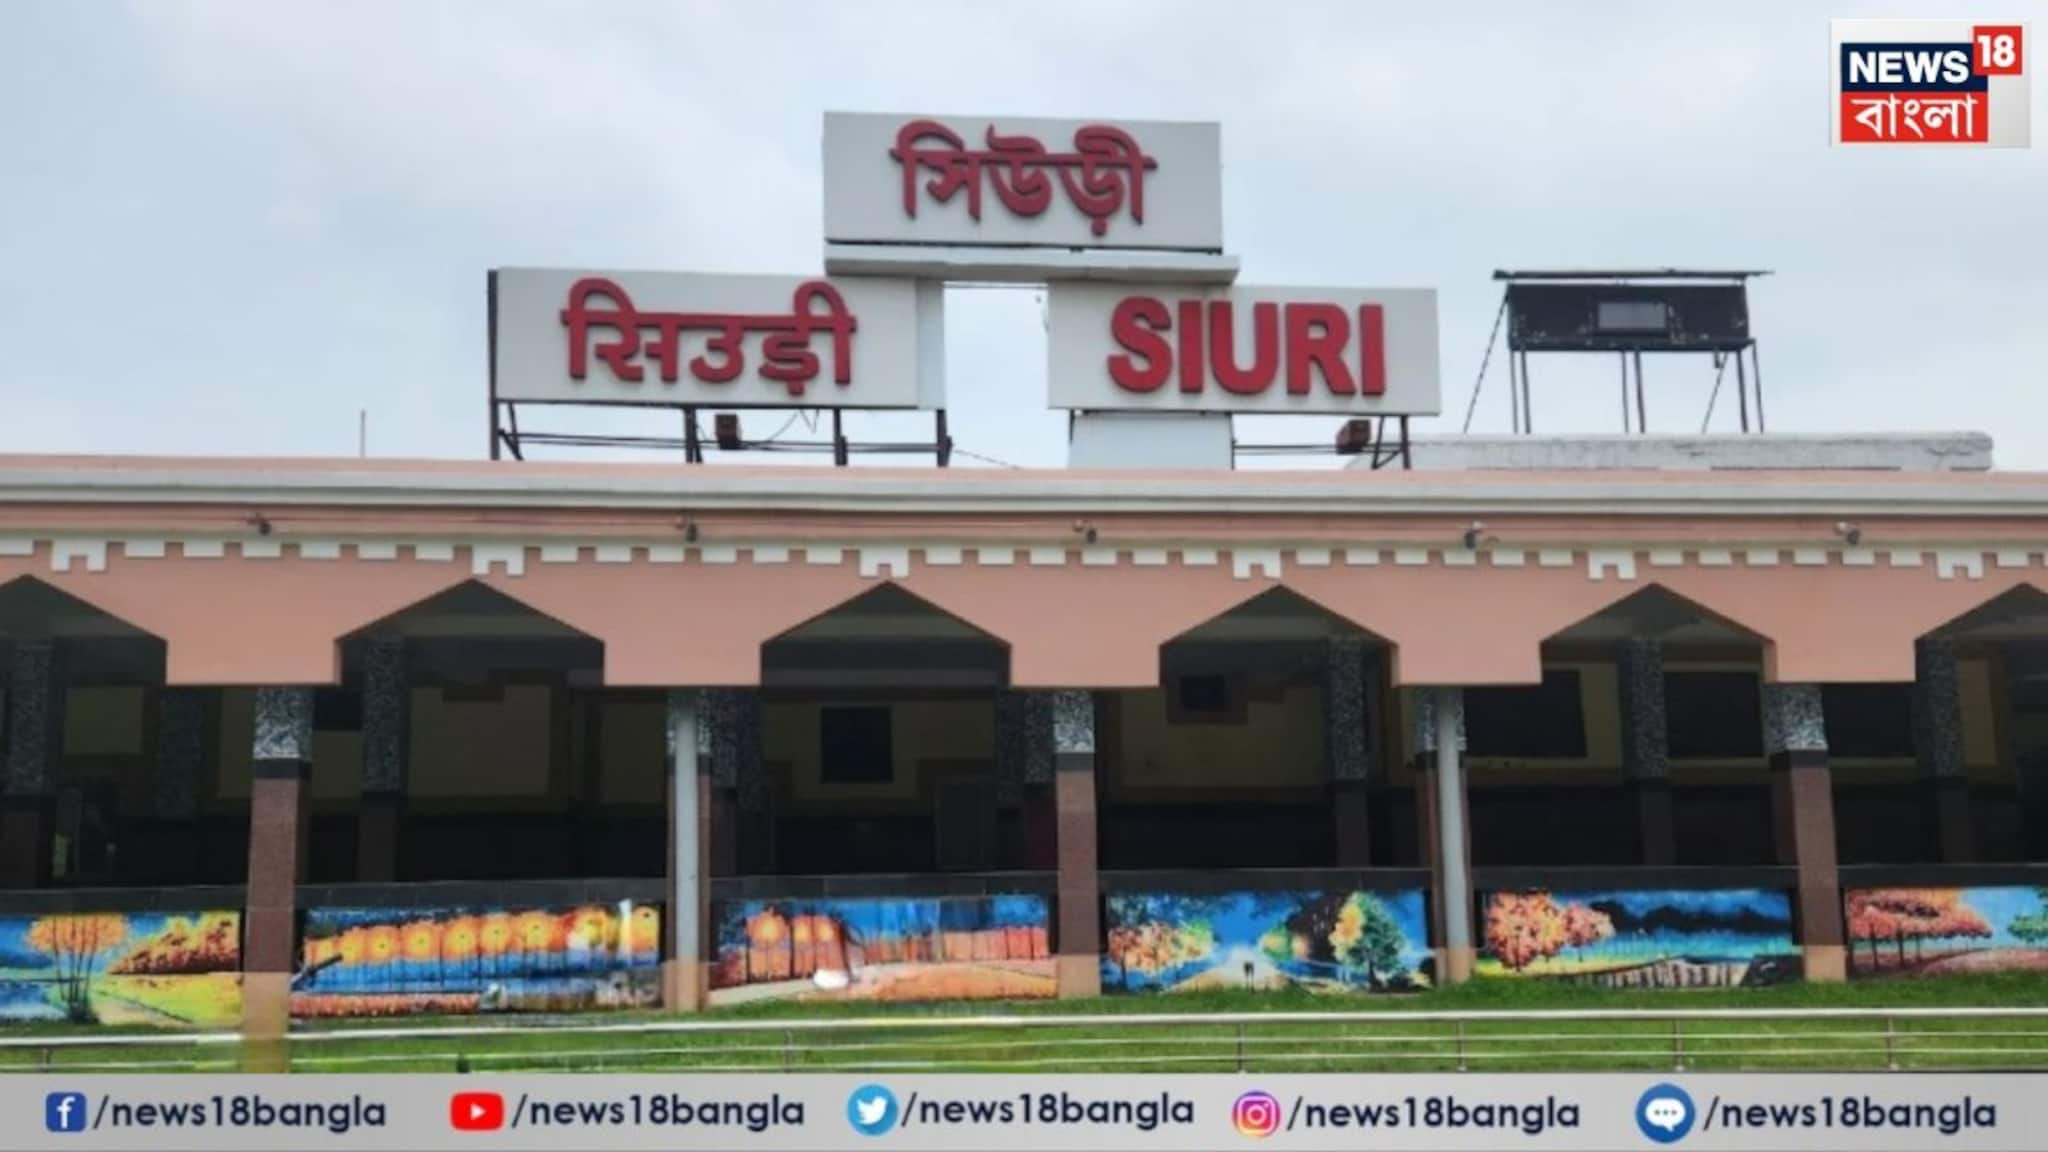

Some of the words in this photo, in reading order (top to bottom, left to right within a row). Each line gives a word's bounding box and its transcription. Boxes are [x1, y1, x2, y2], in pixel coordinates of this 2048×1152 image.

[890, 120, 1157, 236] সিউড়ী
[560, 277, 858, 396] सिउड़ी
[1107, 296, 1387, 395] SIURI
